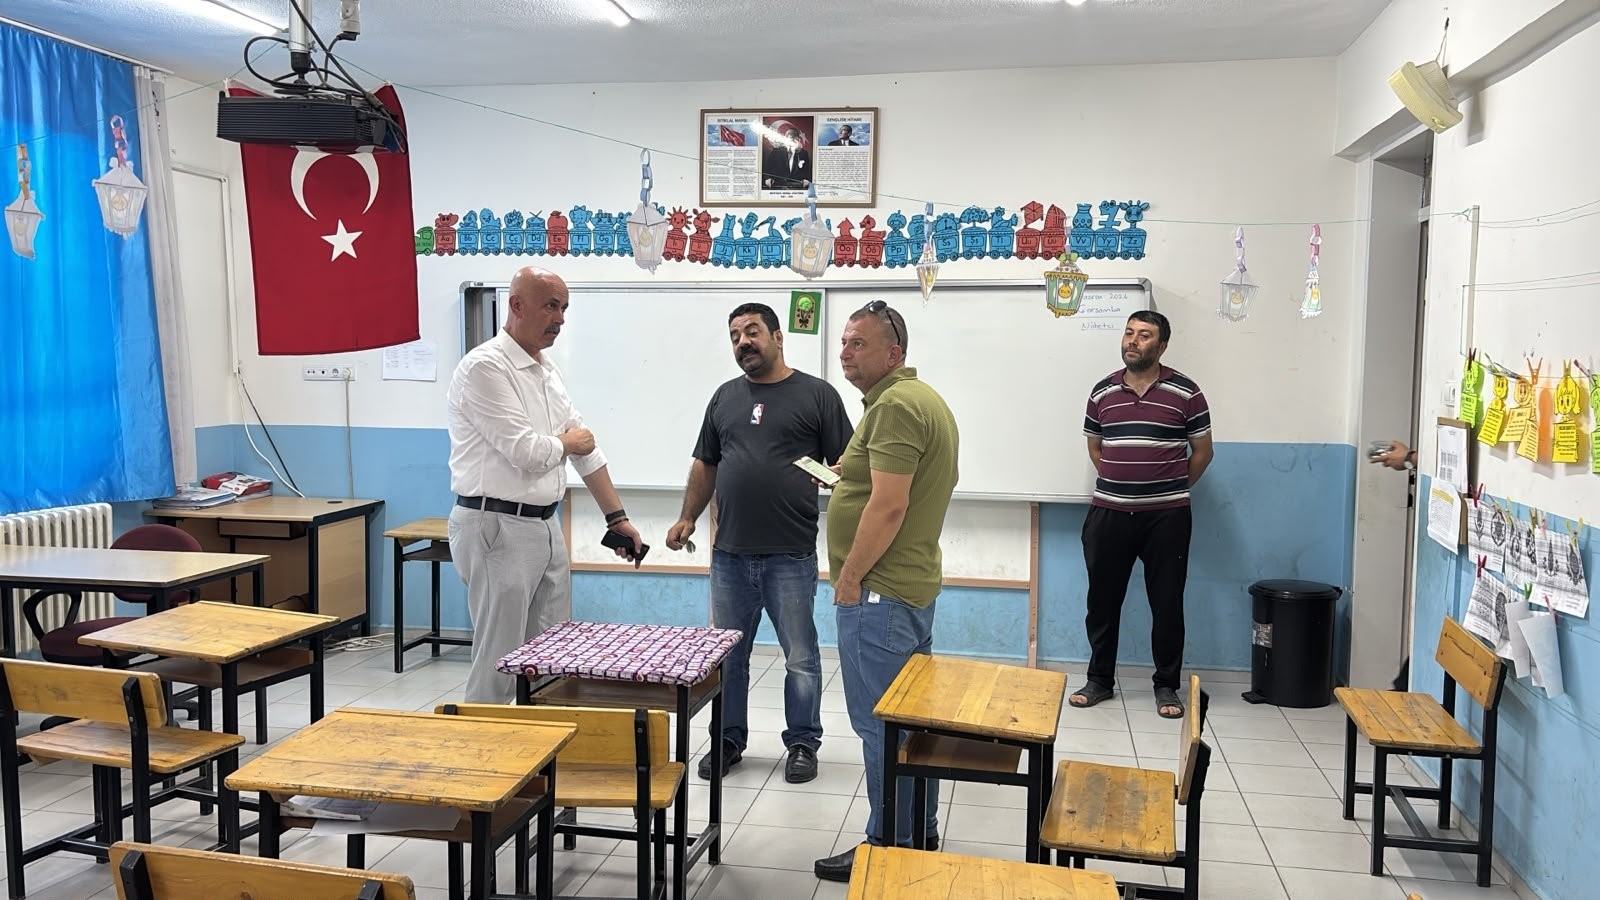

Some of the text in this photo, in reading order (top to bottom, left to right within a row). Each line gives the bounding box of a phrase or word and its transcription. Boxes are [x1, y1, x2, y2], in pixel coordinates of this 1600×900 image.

[553, 234, 561, 242] Ee
[599, 234, 609, 243] Gg
[891, 246, 901, 255] Pp
[1075, 236, 1087, 244] Vv
[1102, 236, 1112, 247] Yy
[1128, 236, 1138, 244] Zz
